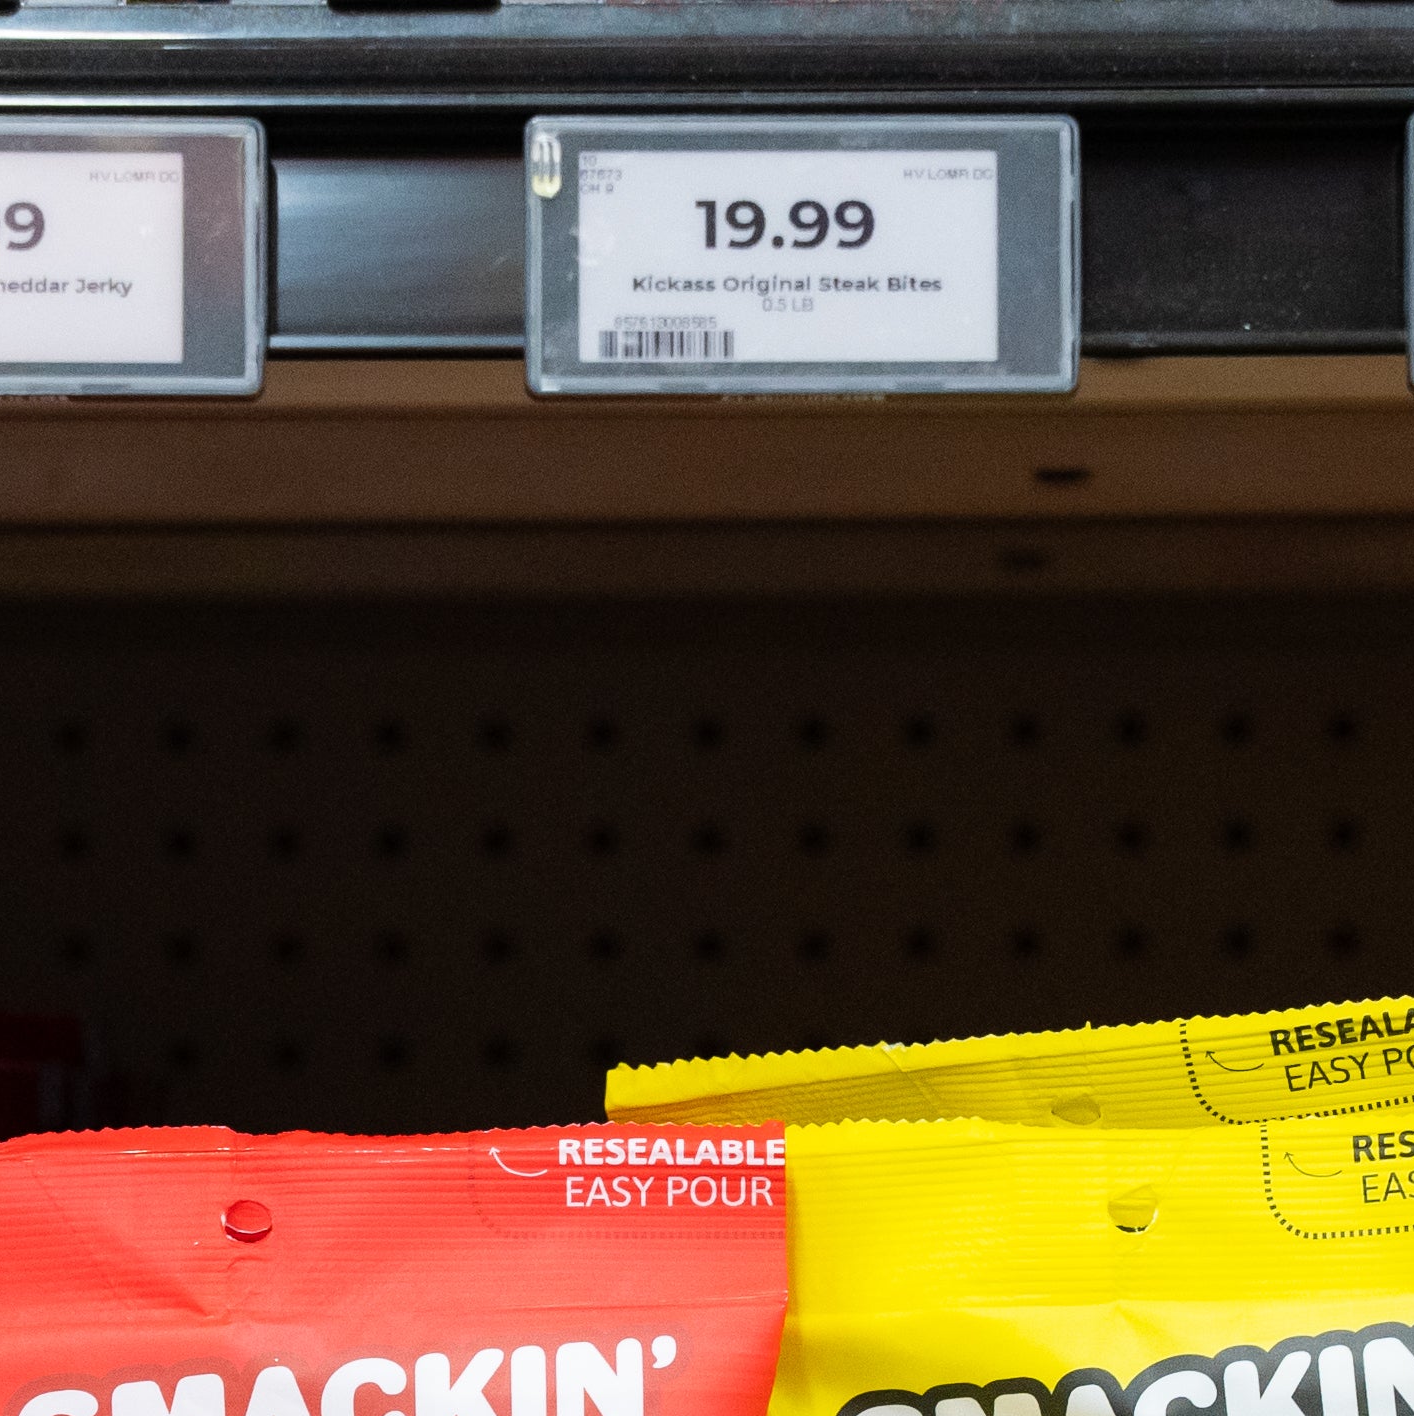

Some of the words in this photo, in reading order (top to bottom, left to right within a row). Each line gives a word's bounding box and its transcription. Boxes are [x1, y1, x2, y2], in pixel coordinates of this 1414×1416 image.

[694, 199, 875, 249] 19.99
[74, 276, 133, 298] Jerky
[632, 276, 716, 293] Kickass
[723, 275, 811, 297] Original
[818, 276, 880, 293] Steak
[887, 276, 942, 293] Bites
[761, 298, 787, 312] 0.5
[791, 298, 814, 312] LB
[1285, 1054, 1370, 1093] EASY
[558, 1137, 786, 1167] RESEALABLE
[565, 1175, 655, 1208] EASY
[667, 1175, 774, 1208] POUR
